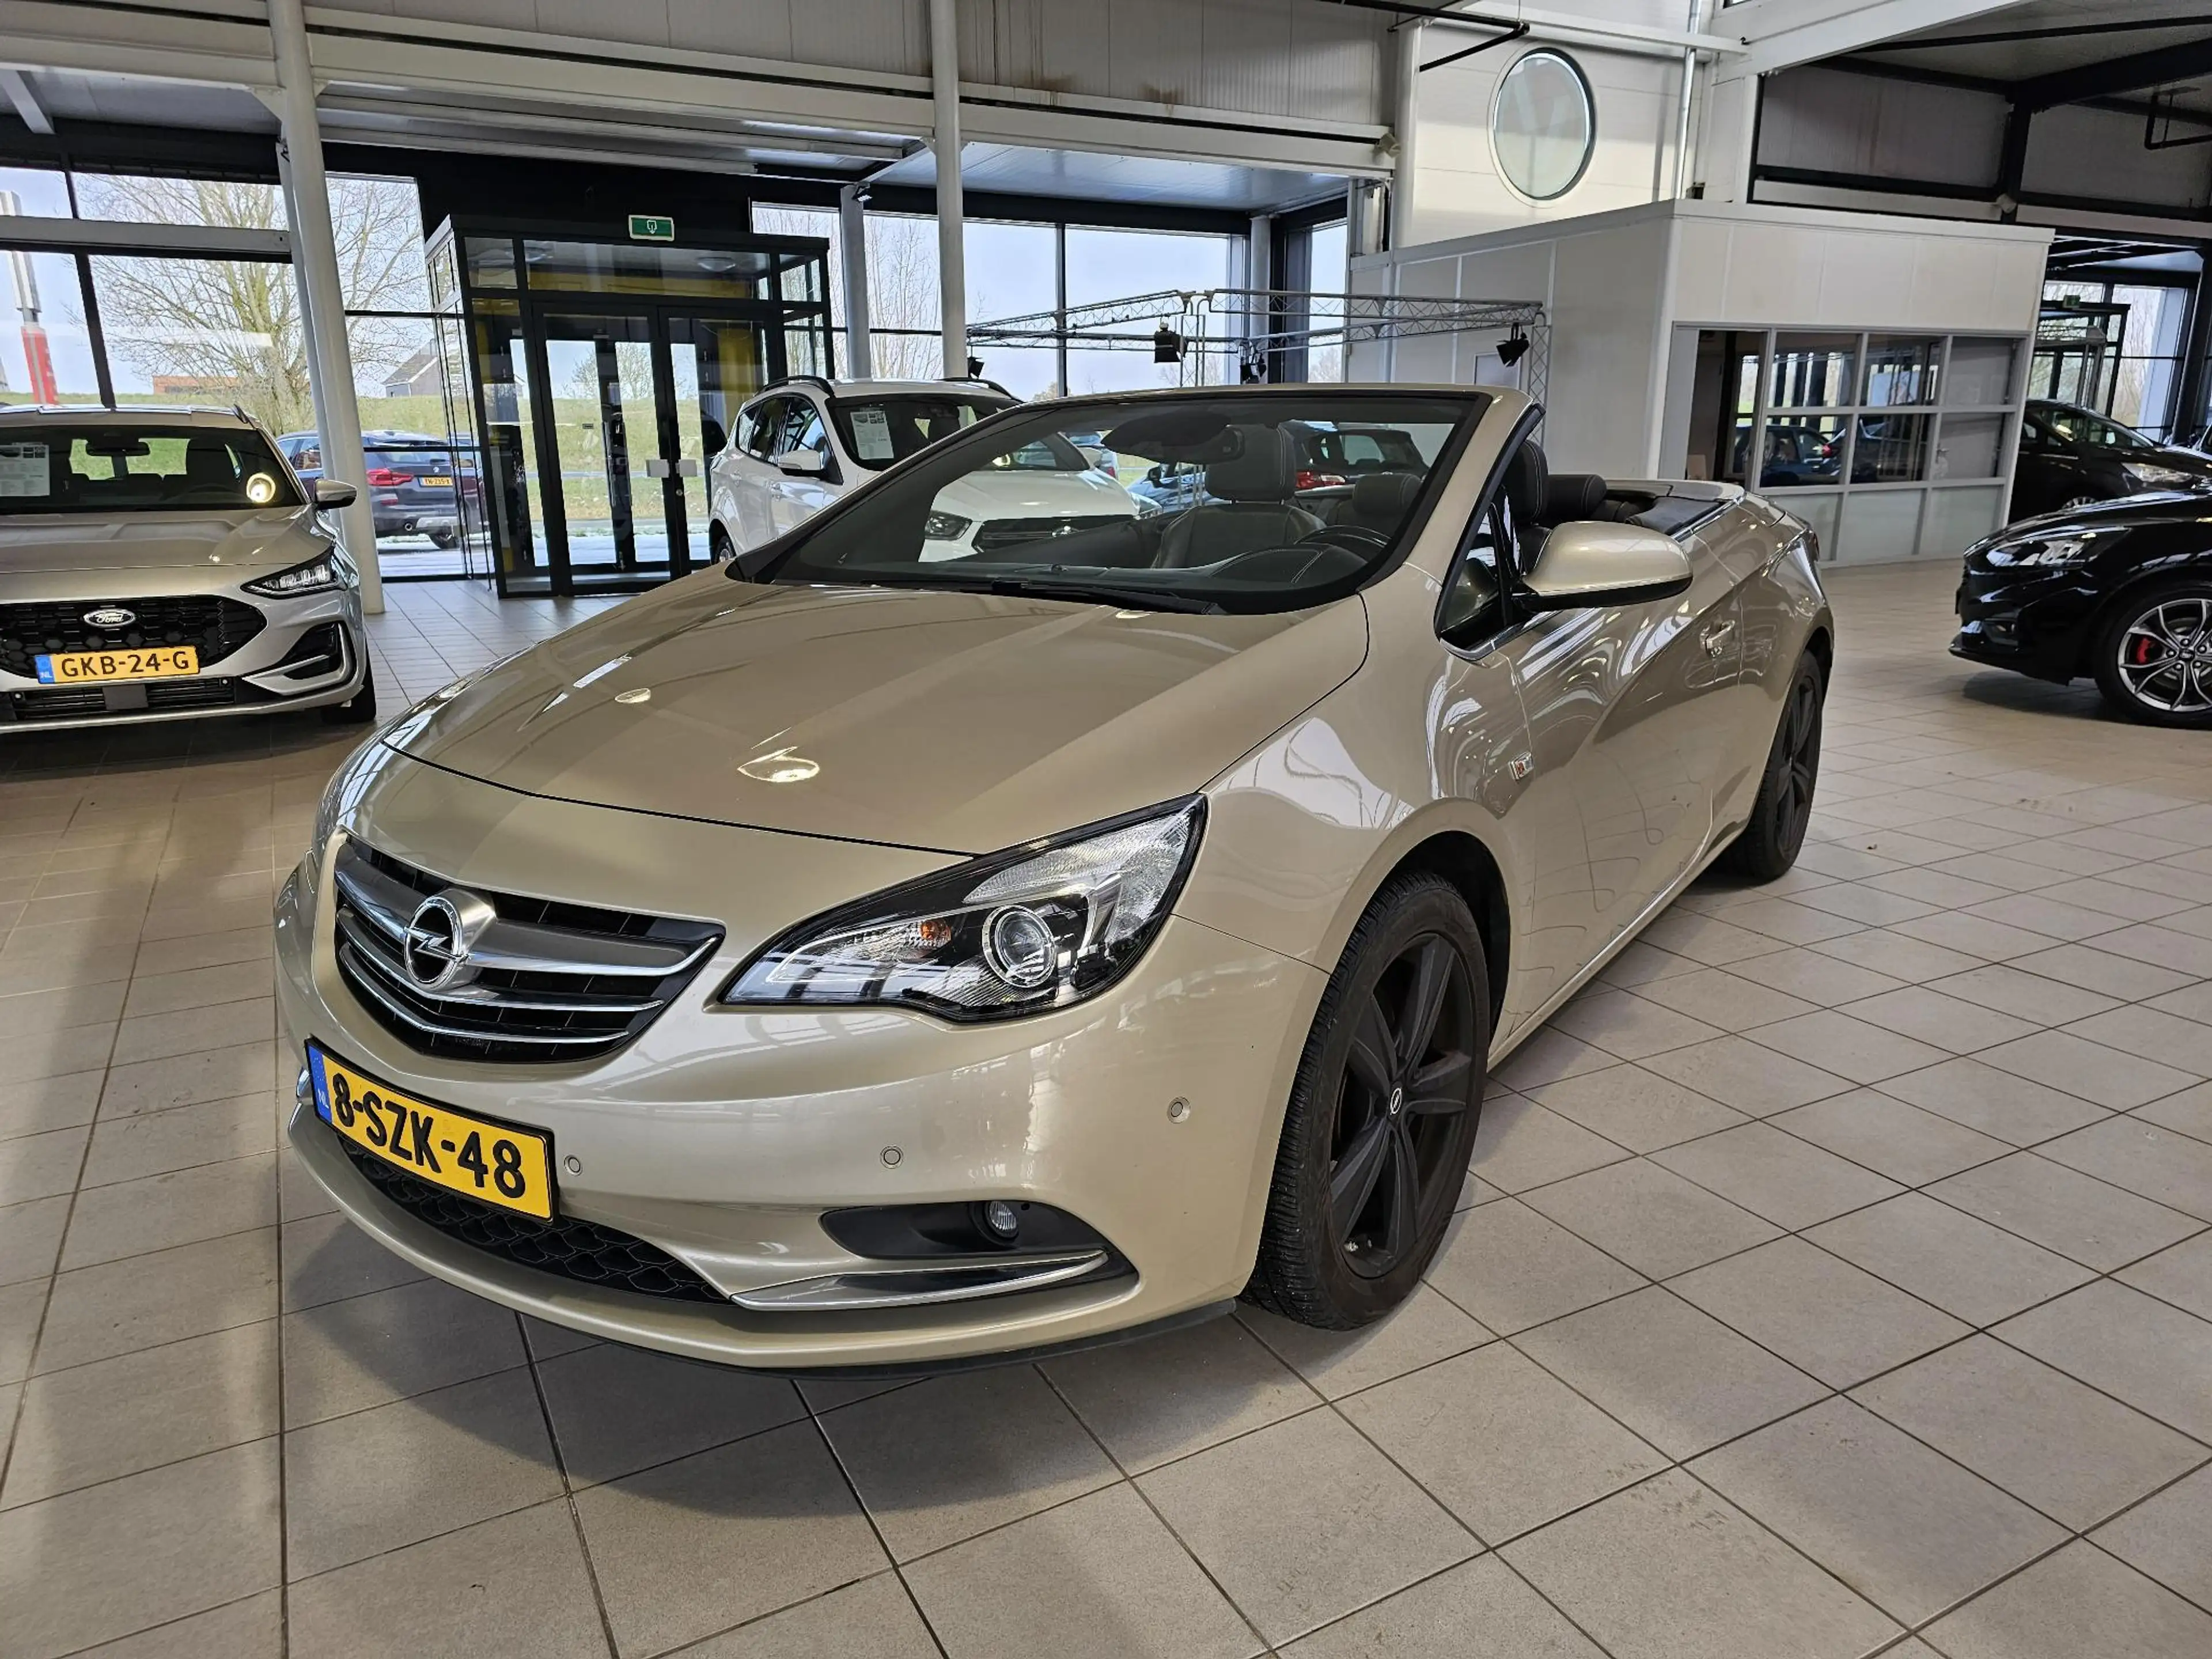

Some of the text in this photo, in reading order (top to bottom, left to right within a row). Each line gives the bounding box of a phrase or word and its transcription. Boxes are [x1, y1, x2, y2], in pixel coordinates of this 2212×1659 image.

[94, 612, 124, 623] Ford
[61, 651, 189, 677] GKB-24-G
[317, 1073, 525, 1199] NL 8-SZK-48
